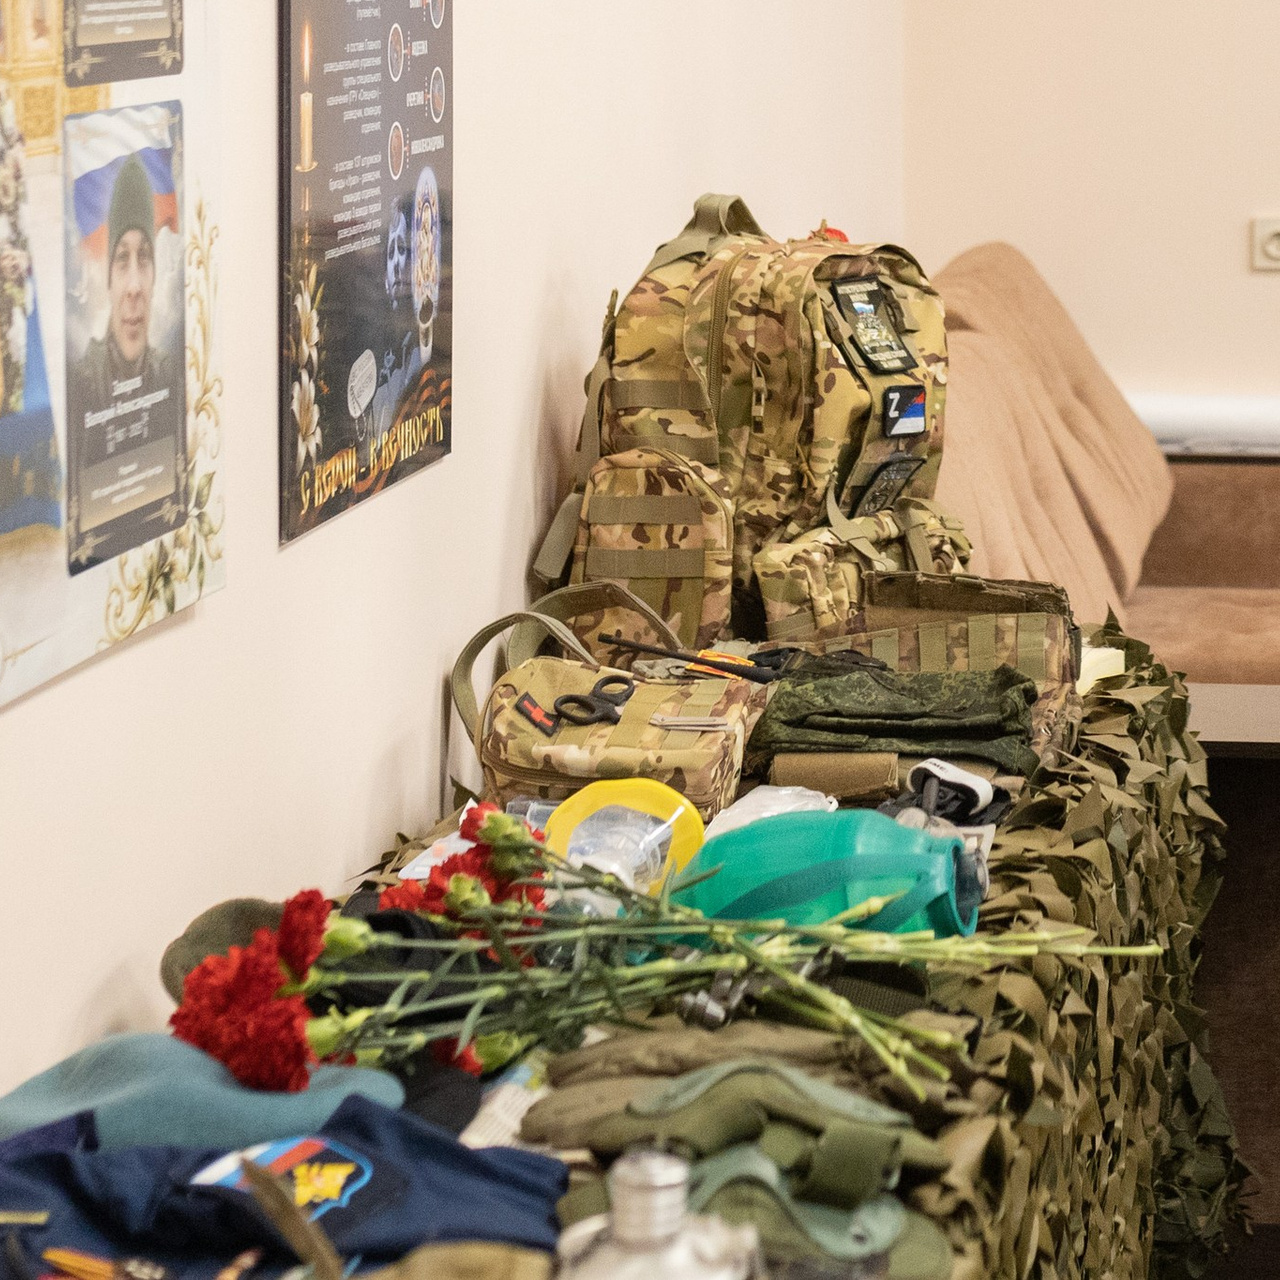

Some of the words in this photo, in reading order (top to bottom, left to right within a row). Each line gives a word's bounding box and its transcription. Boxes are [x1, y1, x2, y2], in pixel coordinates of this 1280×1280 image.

[888, 392, 900, 418] Z
[300, 470, 310, 516] С
[381, 405, 444, 471] ВЕЧНОСТЬ
